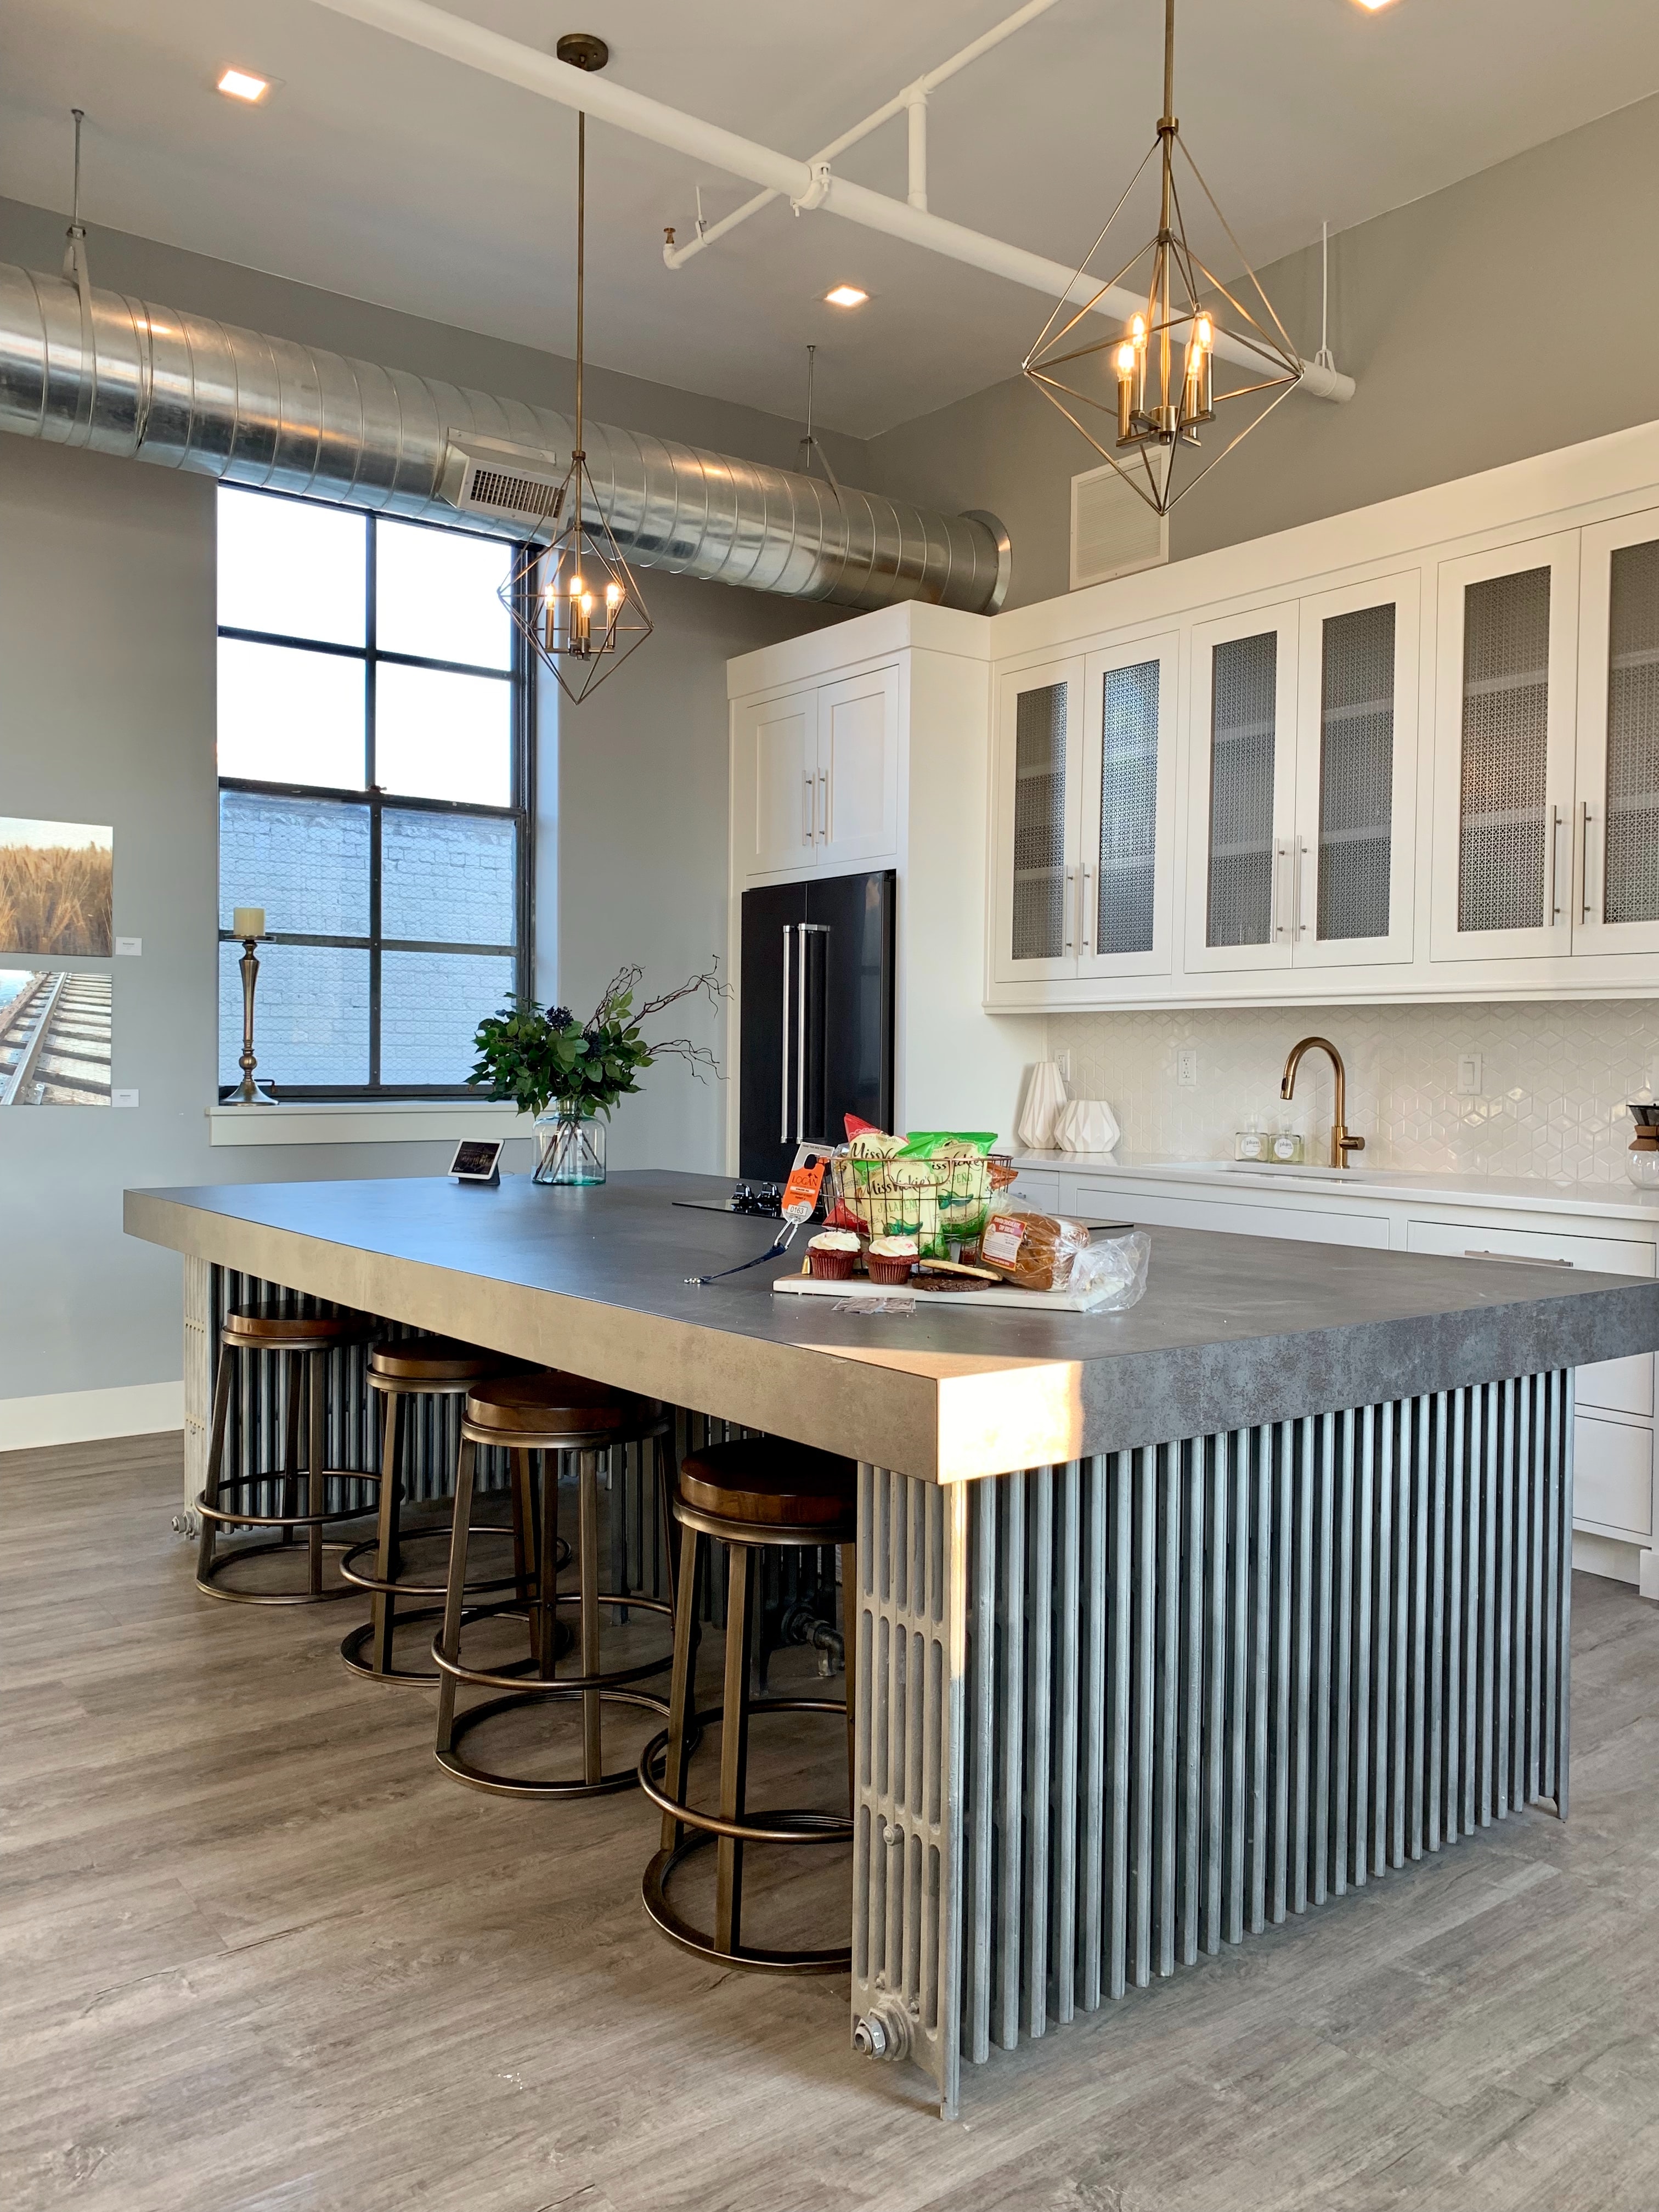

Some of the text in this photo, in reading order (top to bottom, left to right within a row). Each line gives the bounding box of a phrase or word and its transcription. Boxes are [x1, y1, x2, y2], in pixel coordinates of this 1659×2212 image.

[850, 1142, 881, 1159] Miss
[932, 1161, 947, 1170] iss
[792, 1175, 818, 1186] LOGAN
[864, 1180, 892, 1195] Miss
[790, 1206, 804, 1215] 0163
[1003, 1219, 1021, 1229] CHOCOLATE
[1005, 1226, 1014, 1234] BREAD
